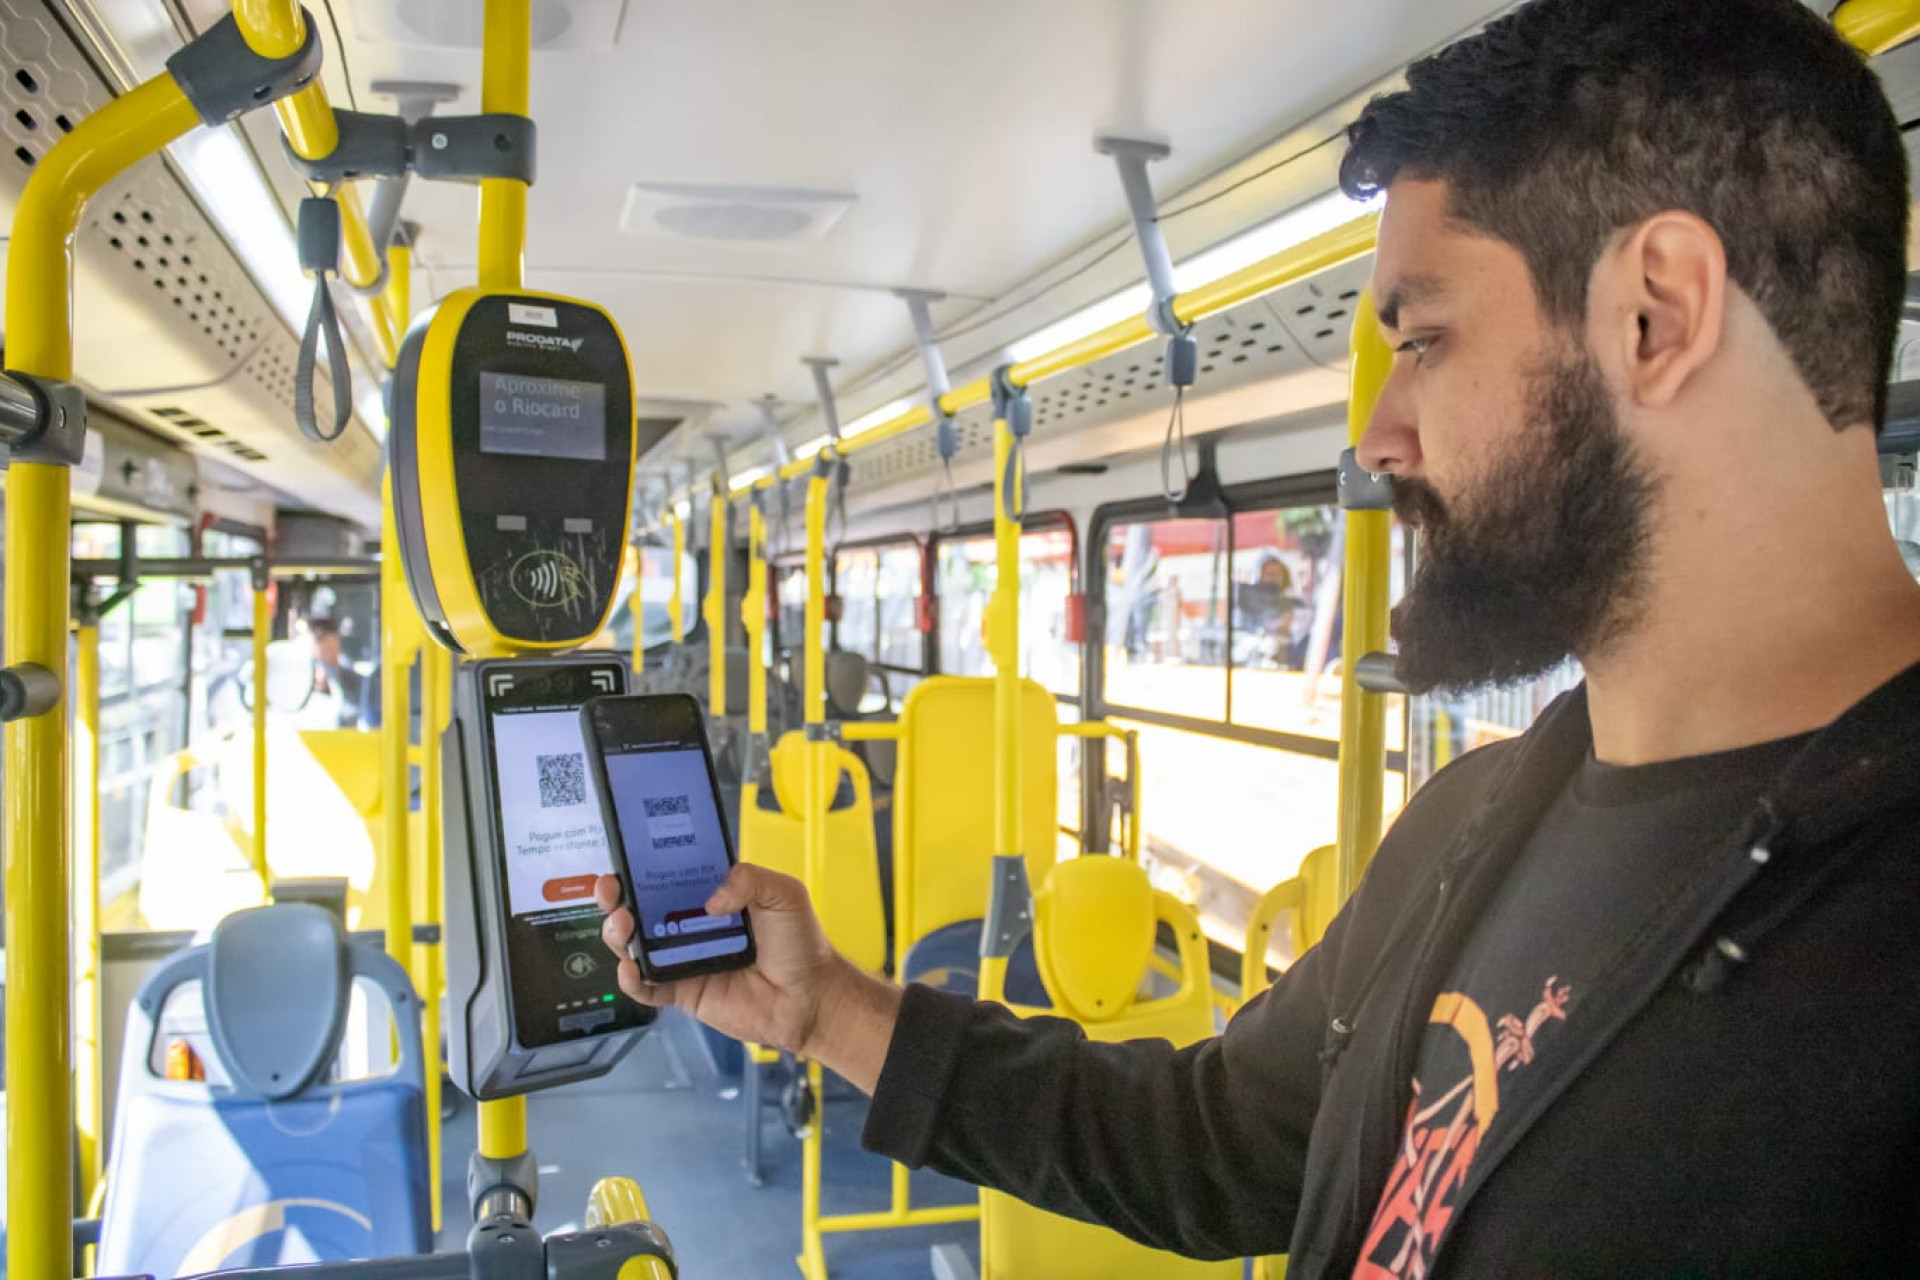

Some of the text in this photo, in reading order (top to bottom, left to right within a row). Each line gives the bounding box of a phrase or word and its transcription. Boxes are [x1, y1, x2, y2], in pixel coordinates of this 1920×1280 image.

[506, 332, 572, 348] PRODATA
[495, 377, 584, 400] Aproxime
[495, 397, 581, 419] o Riocard
[516, 844, 551, 857] Tempo
